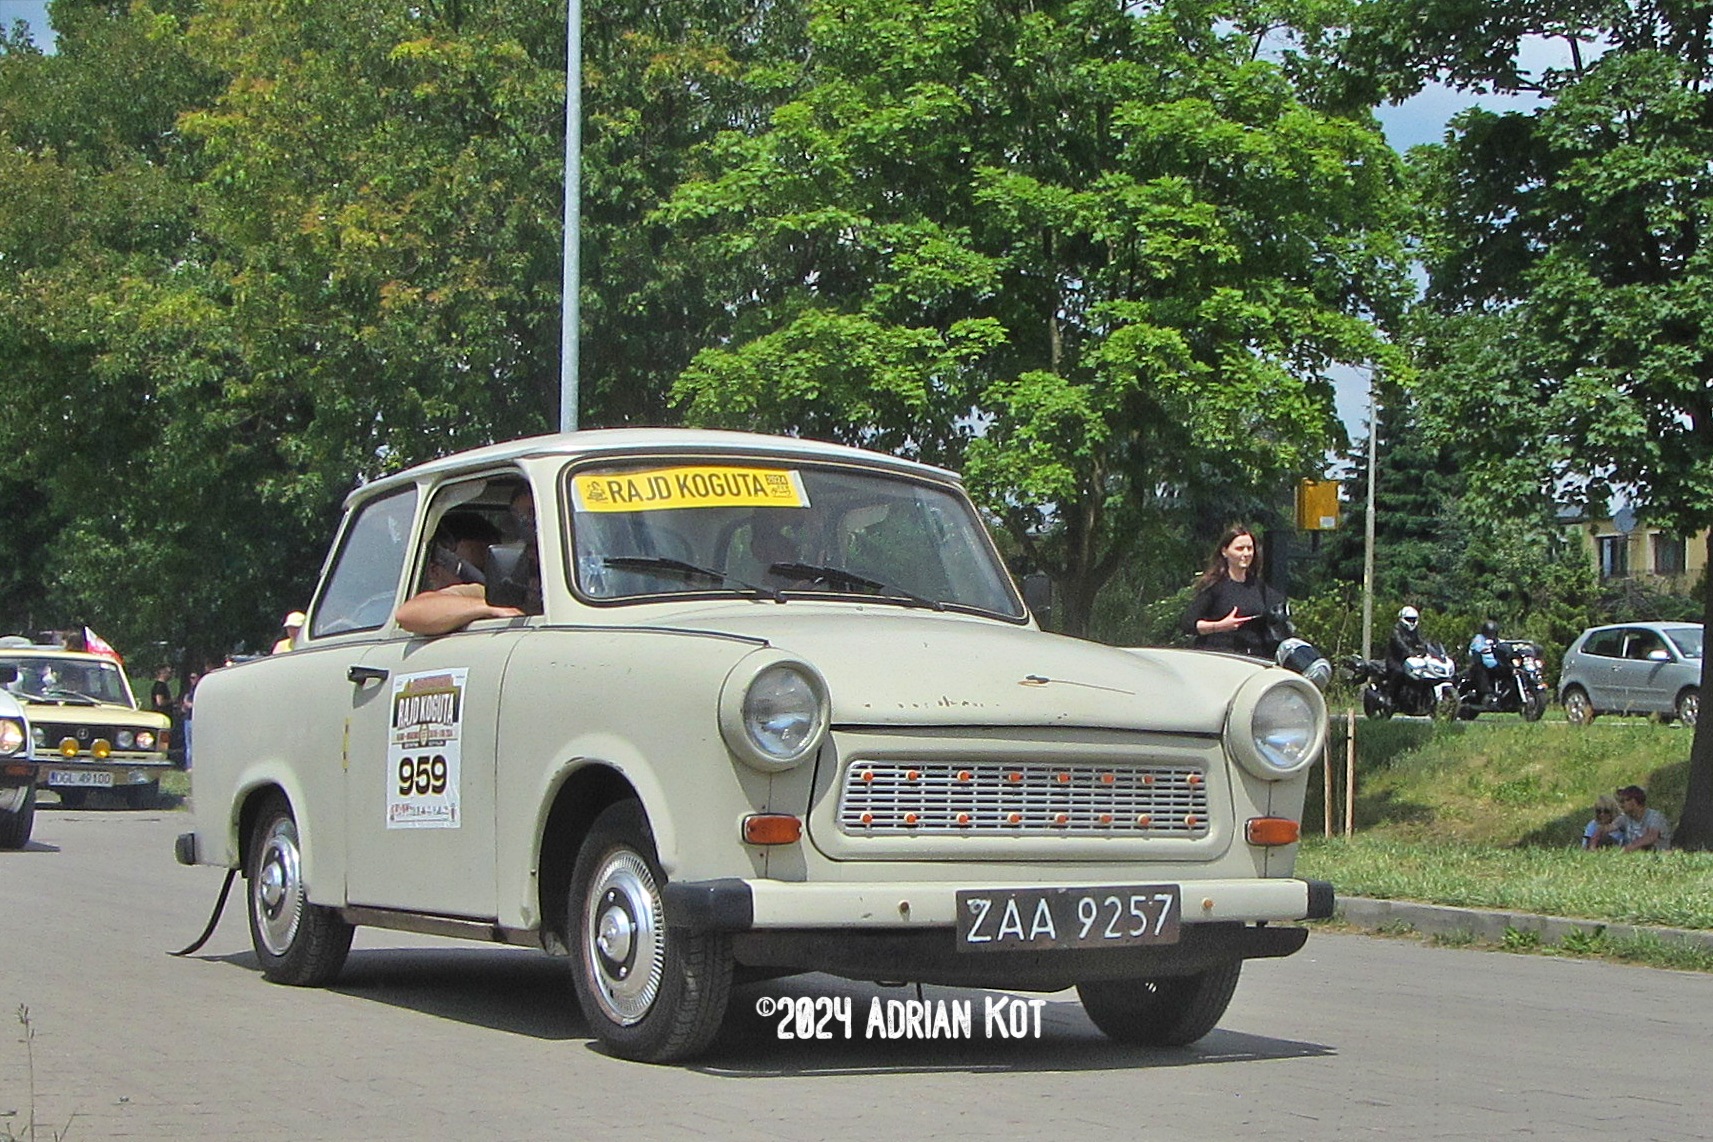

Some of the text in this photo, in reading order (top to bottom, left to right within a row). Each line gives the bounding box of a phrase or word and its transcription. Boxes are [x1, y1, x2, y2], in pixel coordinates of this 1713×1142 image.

[607, 473, 769, 503] RAJD KOGUTA
[398, 693, 453, 728] RAJD KOGUTA
[398, 754, 448, 796] 959
[966, 894, 1173, 941] ZAA 9257
